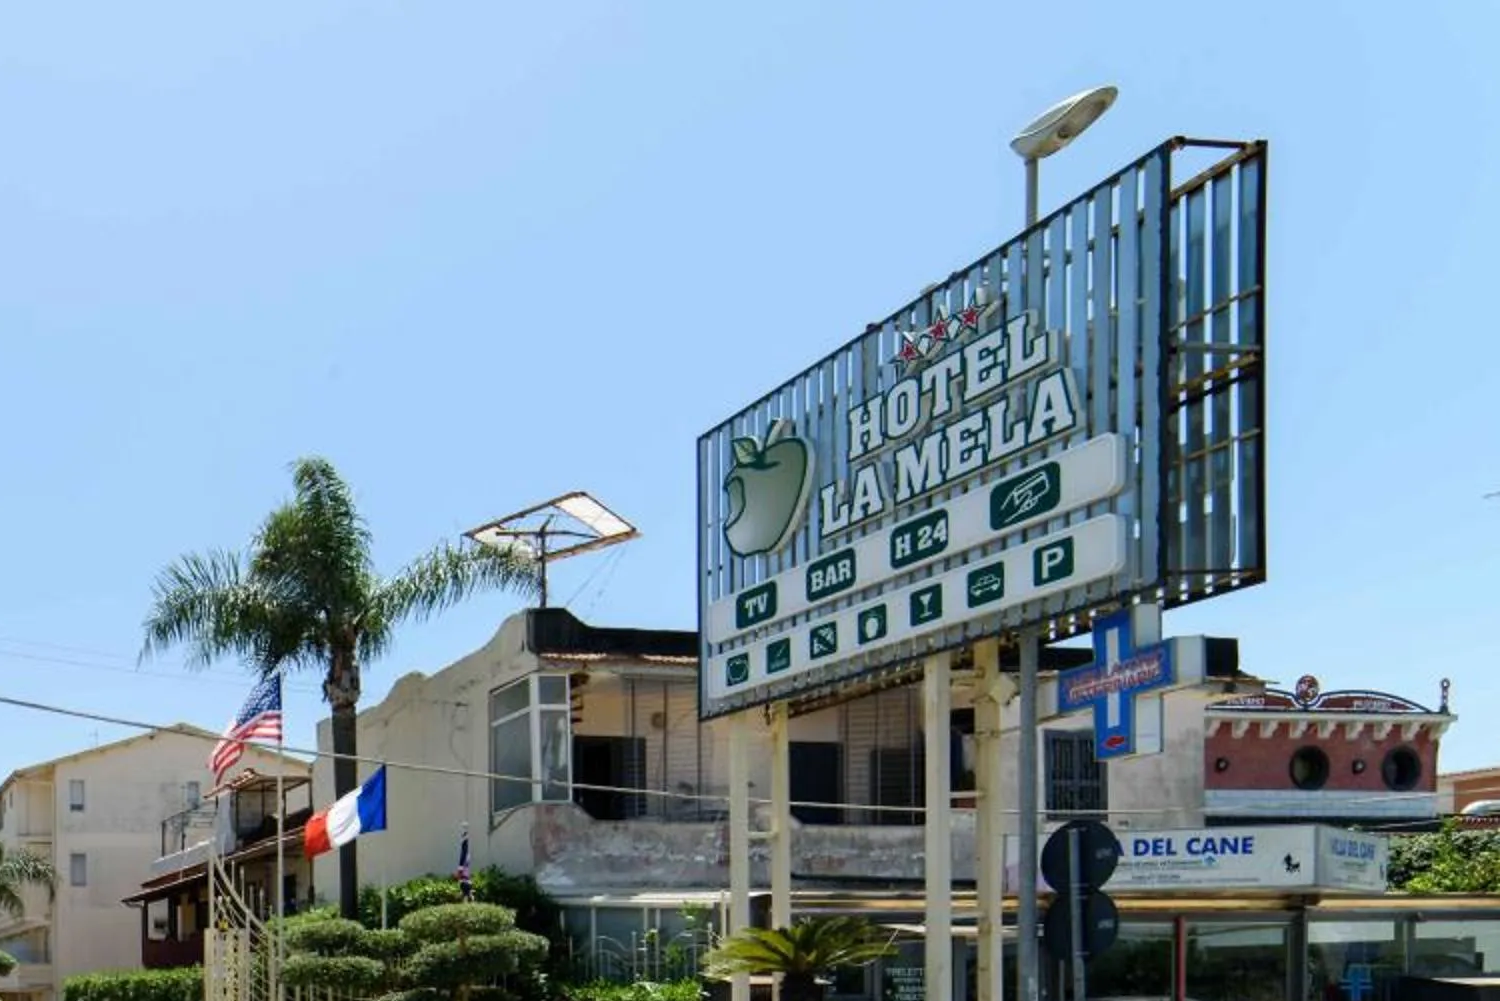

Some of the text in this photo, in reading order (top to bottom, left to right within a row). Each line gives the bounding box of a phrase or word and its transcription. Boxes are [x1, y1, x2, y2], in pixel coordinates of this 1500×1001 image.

[847, 311, 1051, 460] HOTEL
[820, 366, 1078, 538] LA MELA
[894, 518, 947, 562] H 24
[811, 558, 852, 594] BAR
[1041, 546, 1065, 580] P
[744, 591, 768, 618] TV
[1132, 837, 1178, 857] DEL
[1185, 835, 1256, 856] CANE
